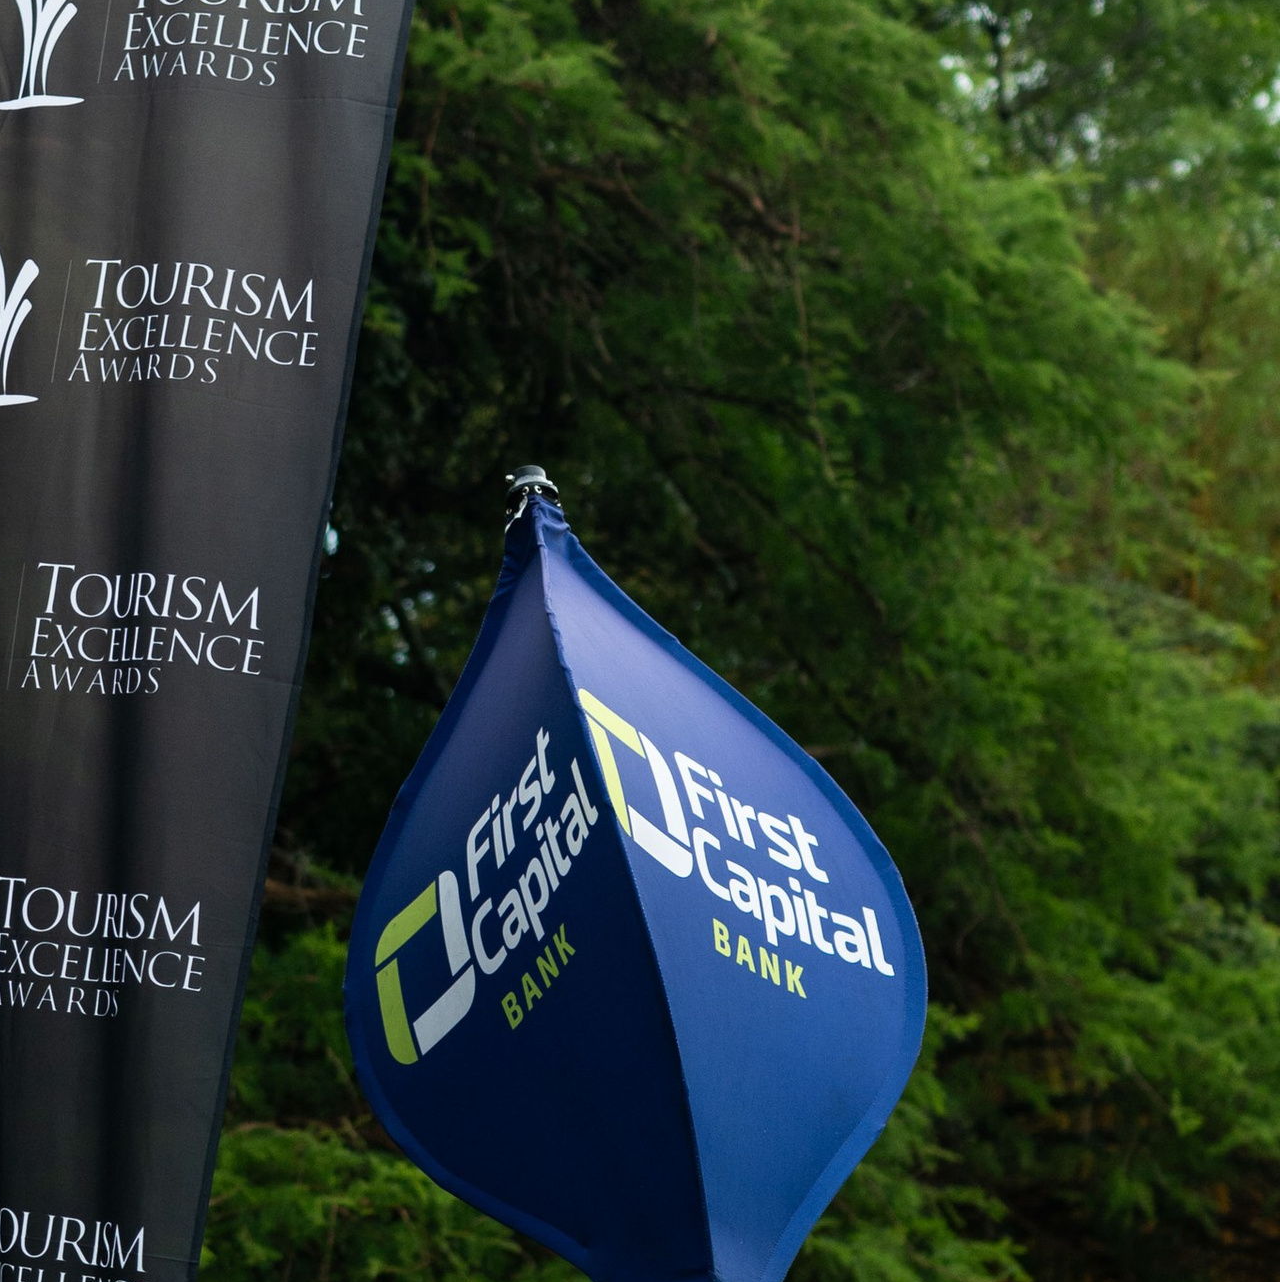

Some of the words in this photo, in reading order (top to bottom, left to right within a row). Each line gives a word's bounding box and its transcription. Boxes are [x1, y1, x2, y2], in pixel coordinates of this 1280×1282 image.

[123, 11, 369, 58] EXCELLENCE
[113, 50, 278, 87] AWARDS
[85, 259, 316, 323] TOURISM
[68, 352, 220, 384] AWARDS
[78, 312, 319, 367] EXCELLENCE
[37, 562, 261, 631] TOURISM
[21, 659, 162, 695] AWARDS
[30, 617, 265, 676] EXCELLENCE
[466, 726, 556, 902] First
[674, 751, 830, 884] First
[471, 757, 599, 975] Capital
[692, 826, 895, 976] Capital
[501, 923, 576, 1030] BANK
[712, 917, 808, 999] BANK
